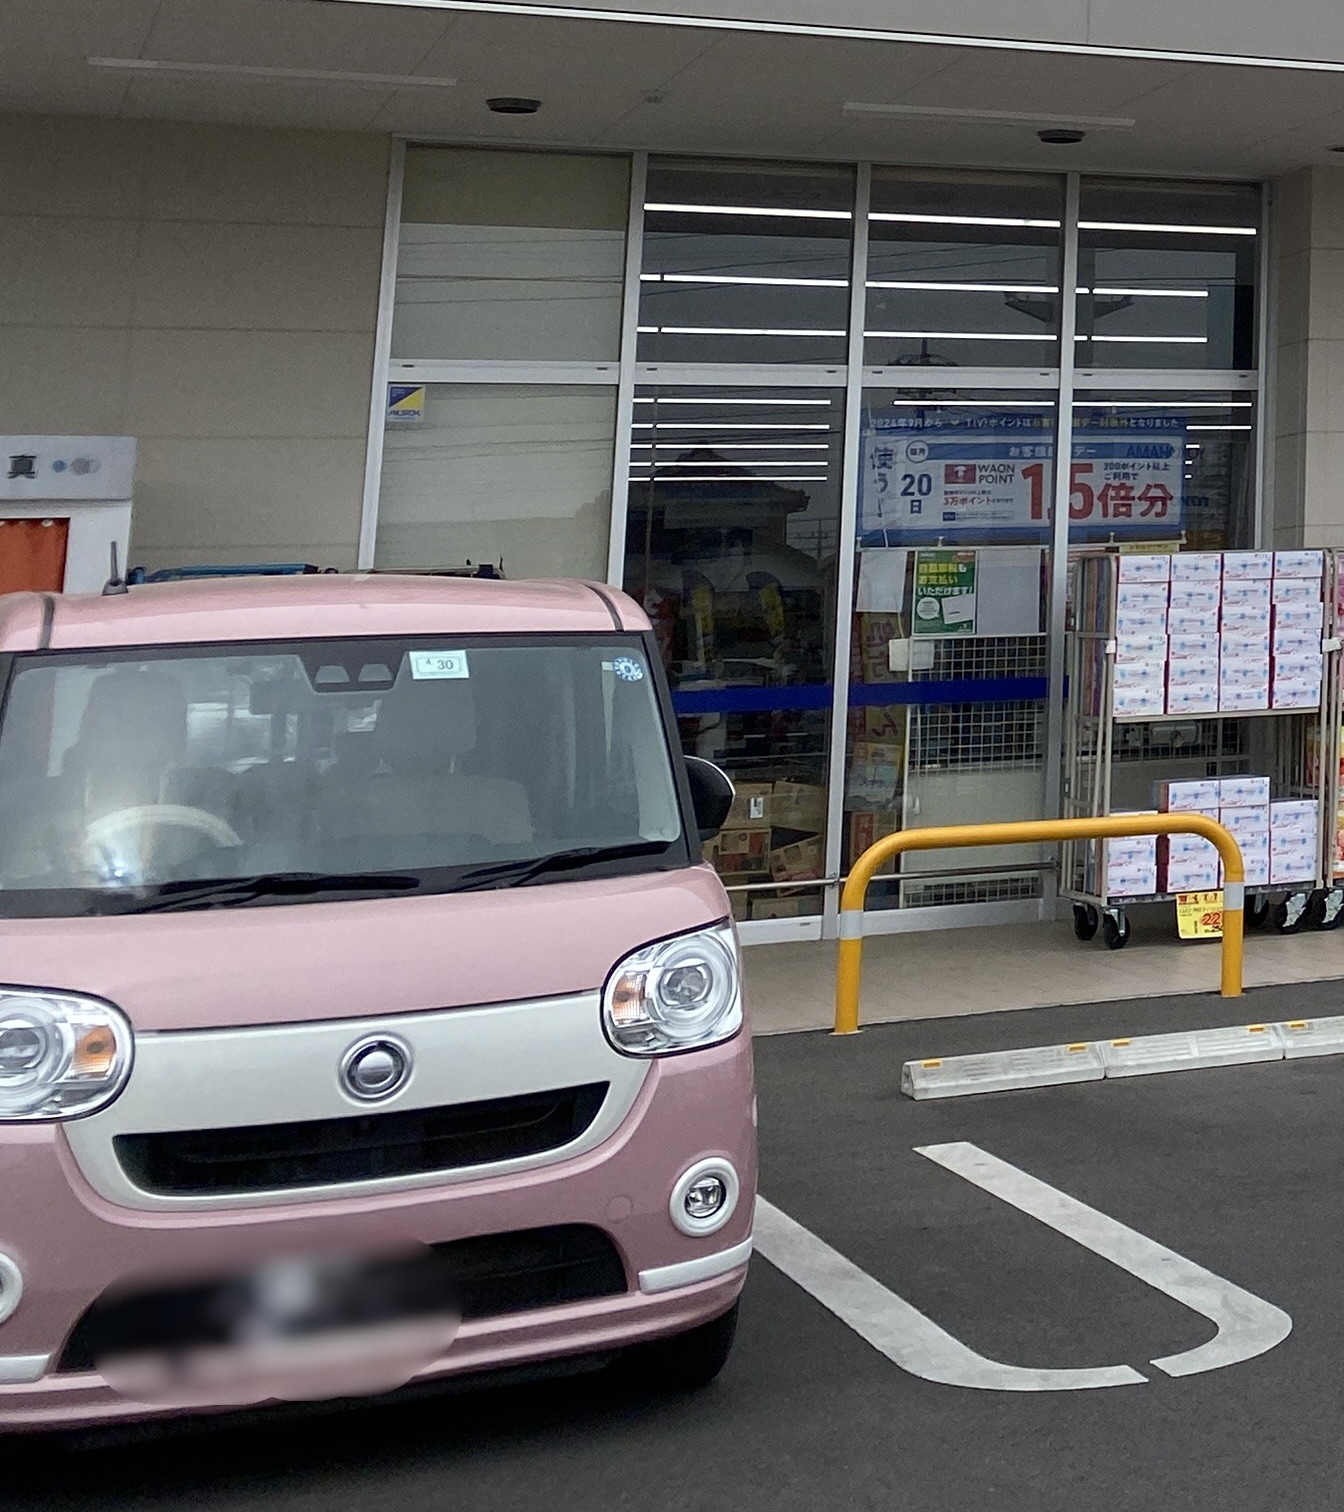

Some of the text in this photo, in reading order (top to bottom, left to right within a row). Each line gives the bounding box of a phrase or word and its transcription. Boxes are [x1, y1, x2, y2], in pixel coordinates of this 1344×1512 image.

[979, 474, 1015, 484] POINT
[901, 473, 933, 497] 20
[437, 659, 454, 670] 30
